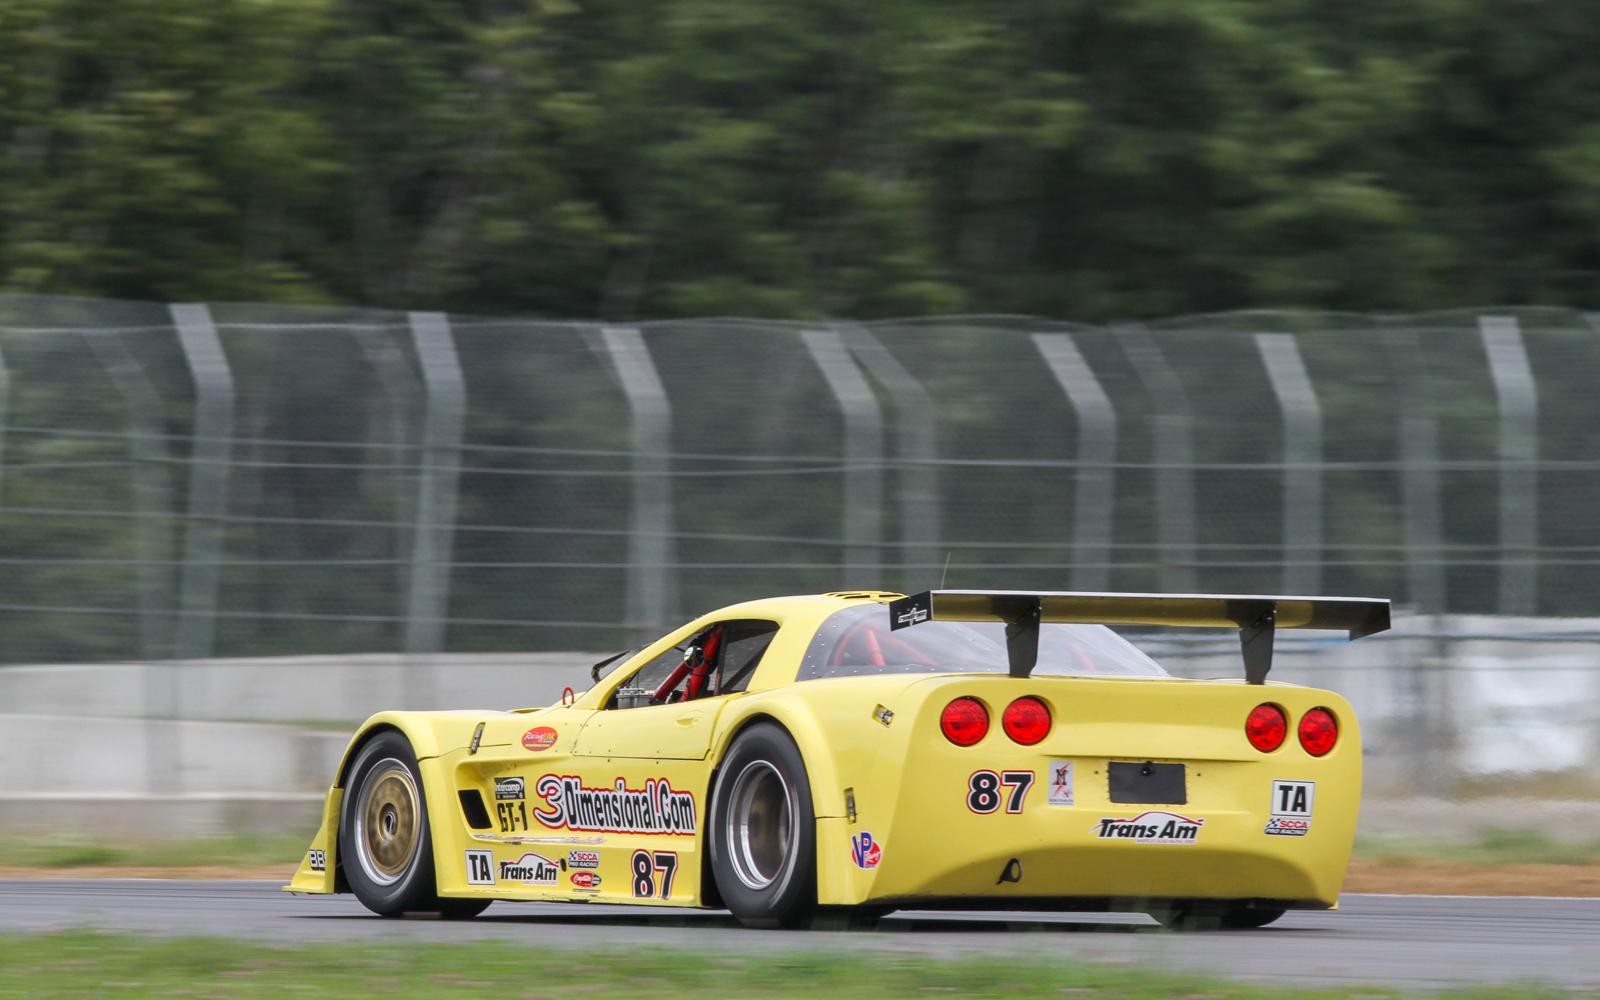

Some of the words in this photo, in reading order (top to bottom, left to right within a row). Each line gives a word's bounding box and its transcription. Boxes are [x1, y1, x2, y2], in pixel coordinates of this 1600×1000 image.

[967, 770, 1034, 814] 87
[1279, 785, 1306, 812] TA
[497, 801, 528, 832] GT-1
[1099, 819, 1159, 838] Trans
[1159, 820, 1197, 839] Am
[1280, 820, 1308, 829] SCCA
[577, 853, 598, 861] SCCA
[852, 832, 872, 869] VP
[469, 855, 491, 881] TA
[500, 861, 533, 880] Trans
[535, 862, 557, 880] Am
[631, 849, 678, 899] 87
